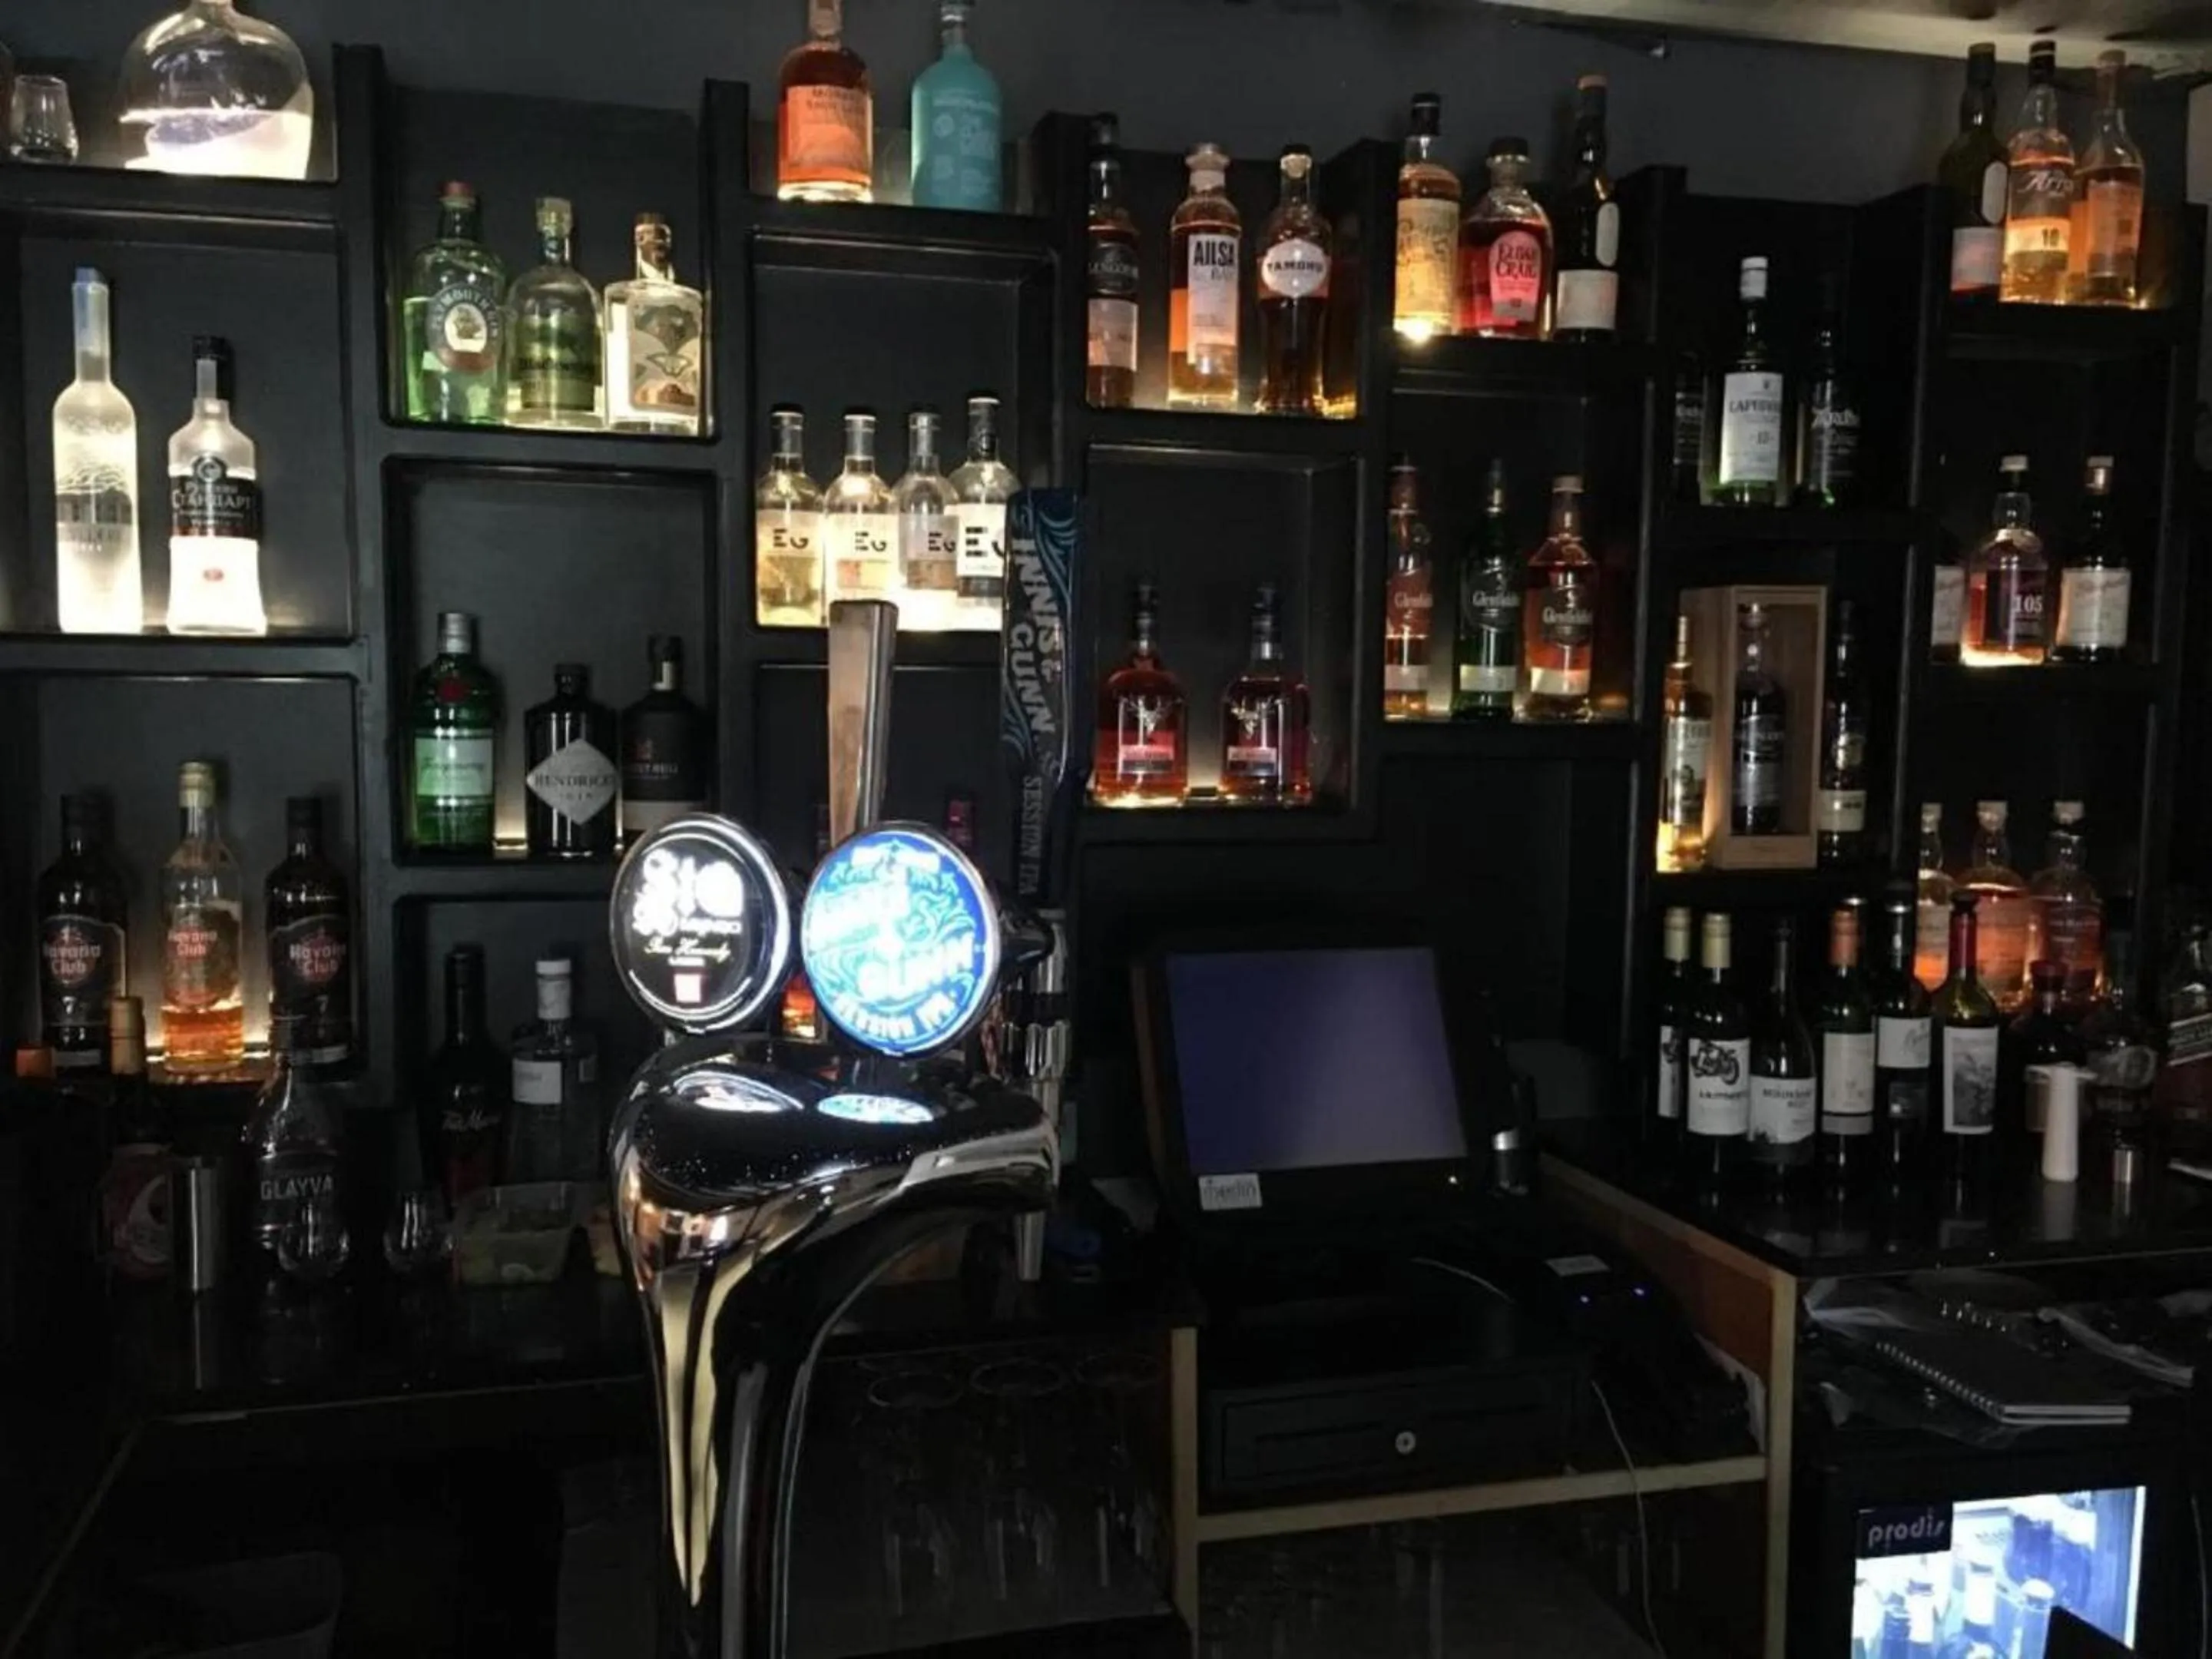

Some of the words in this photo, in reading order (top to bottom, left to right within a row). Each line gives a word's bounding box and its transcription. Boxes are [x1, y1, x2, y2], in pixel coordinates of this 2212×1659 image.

[2015, 595, 2043, 613] 105
[1010, 623, 1056, 732] GUNN
[176, 942, 207, 957] Club
[51, 959, 88, 976] Club
[260, 1172, 334, 1201] GLAYVA
